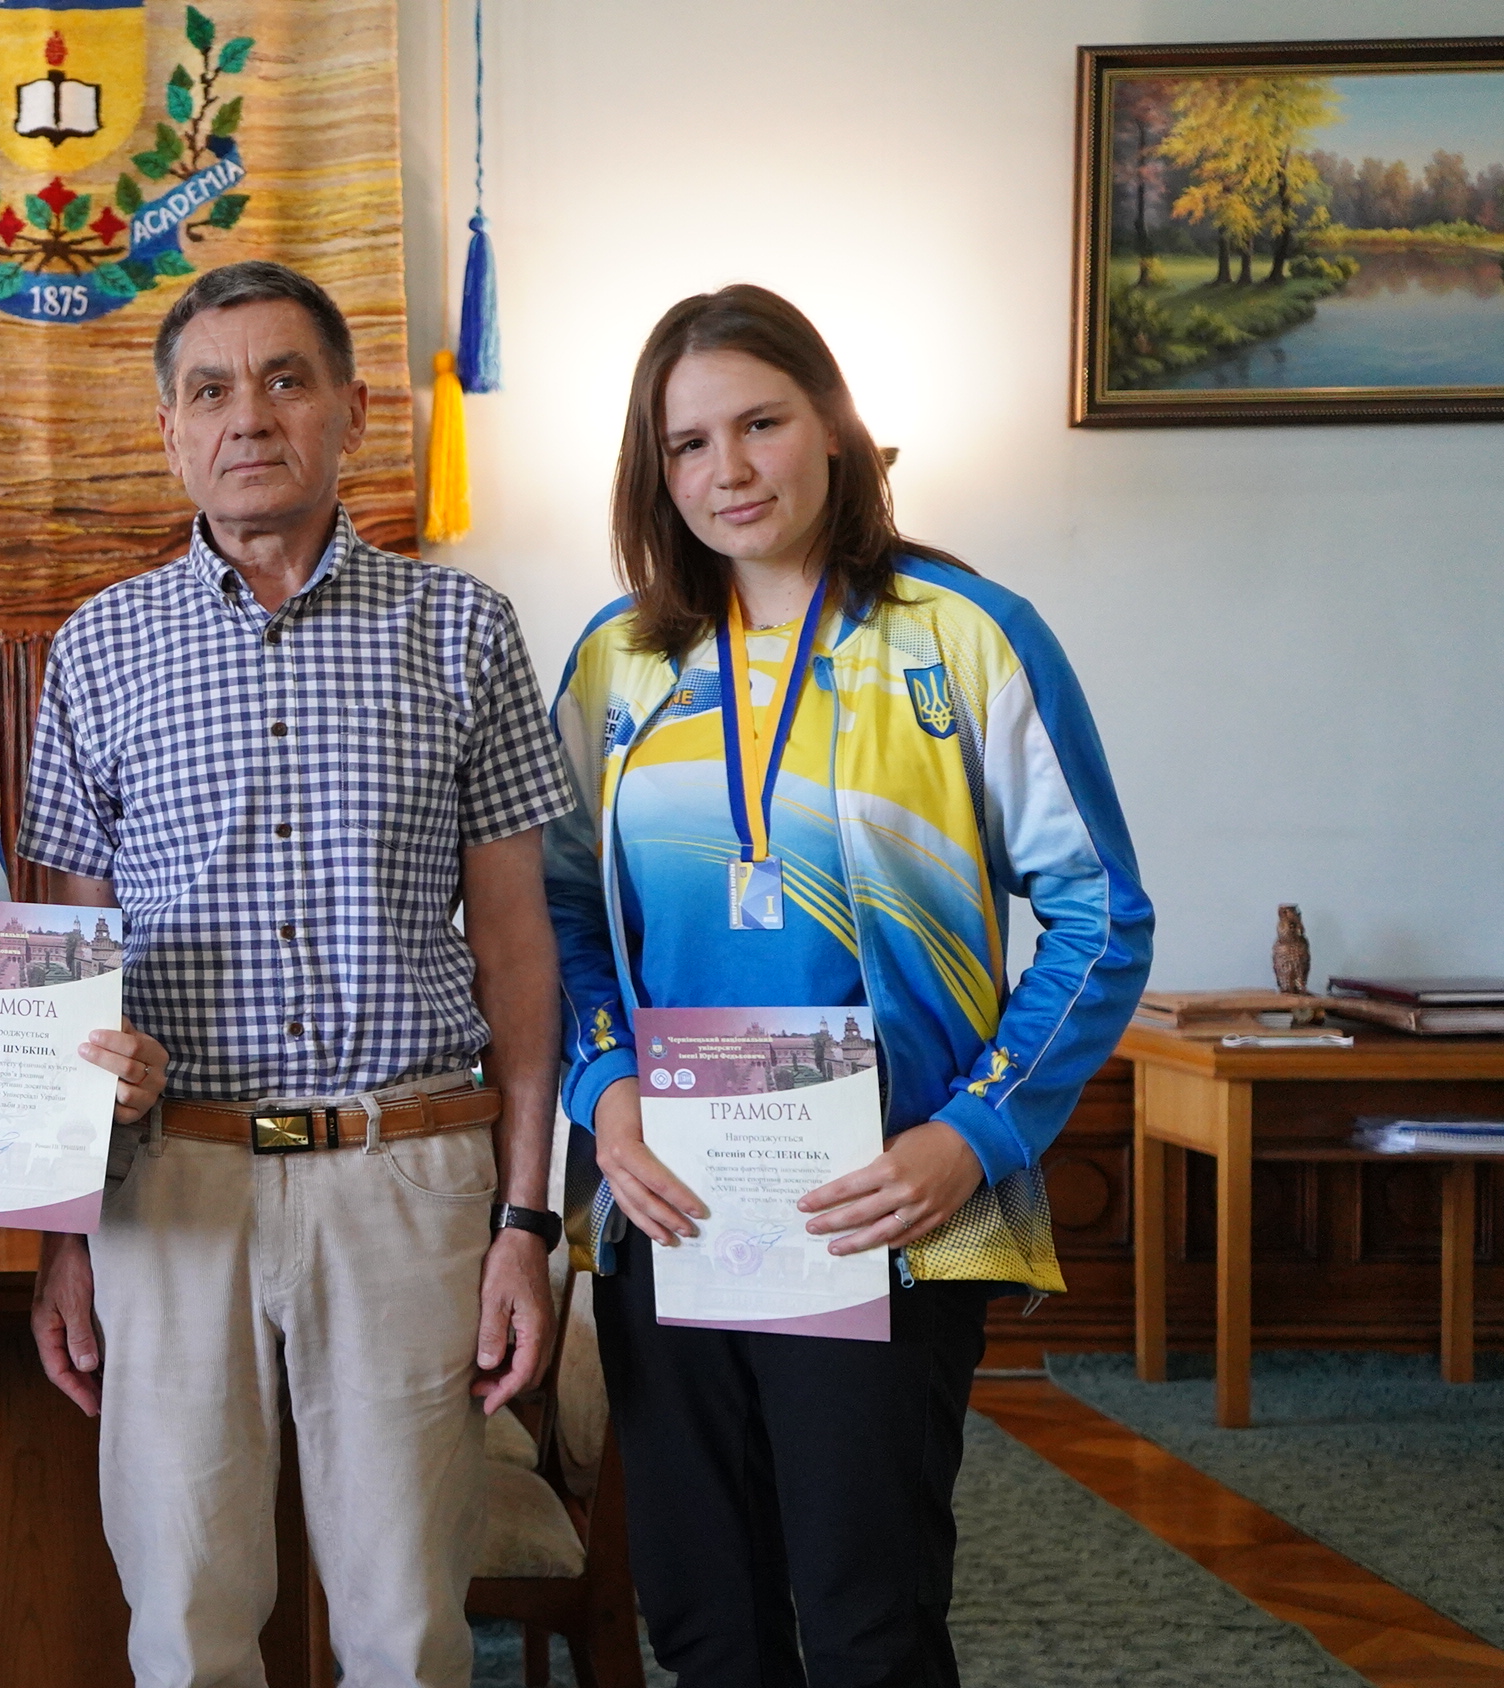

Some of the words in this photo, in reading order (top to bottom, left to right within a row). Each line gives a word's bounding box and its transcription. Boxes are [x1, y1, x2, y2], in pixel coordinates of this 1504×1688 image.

[132, 158, 246, 245] ACADEMIA
[29, 284, 89, 317] 1875
[765, 895, 775, 914] I
[3, 1044, 56, 1056] ШУБКІНА
[710, 1102, 812, 1121] ГРАМОТА
[725, 1132, 804, 1144] Нагороджується
[707, 1149, 746, 1159] Євгенія
[749, 1149, 830, 1160] СУСЛЕНСЬКА
